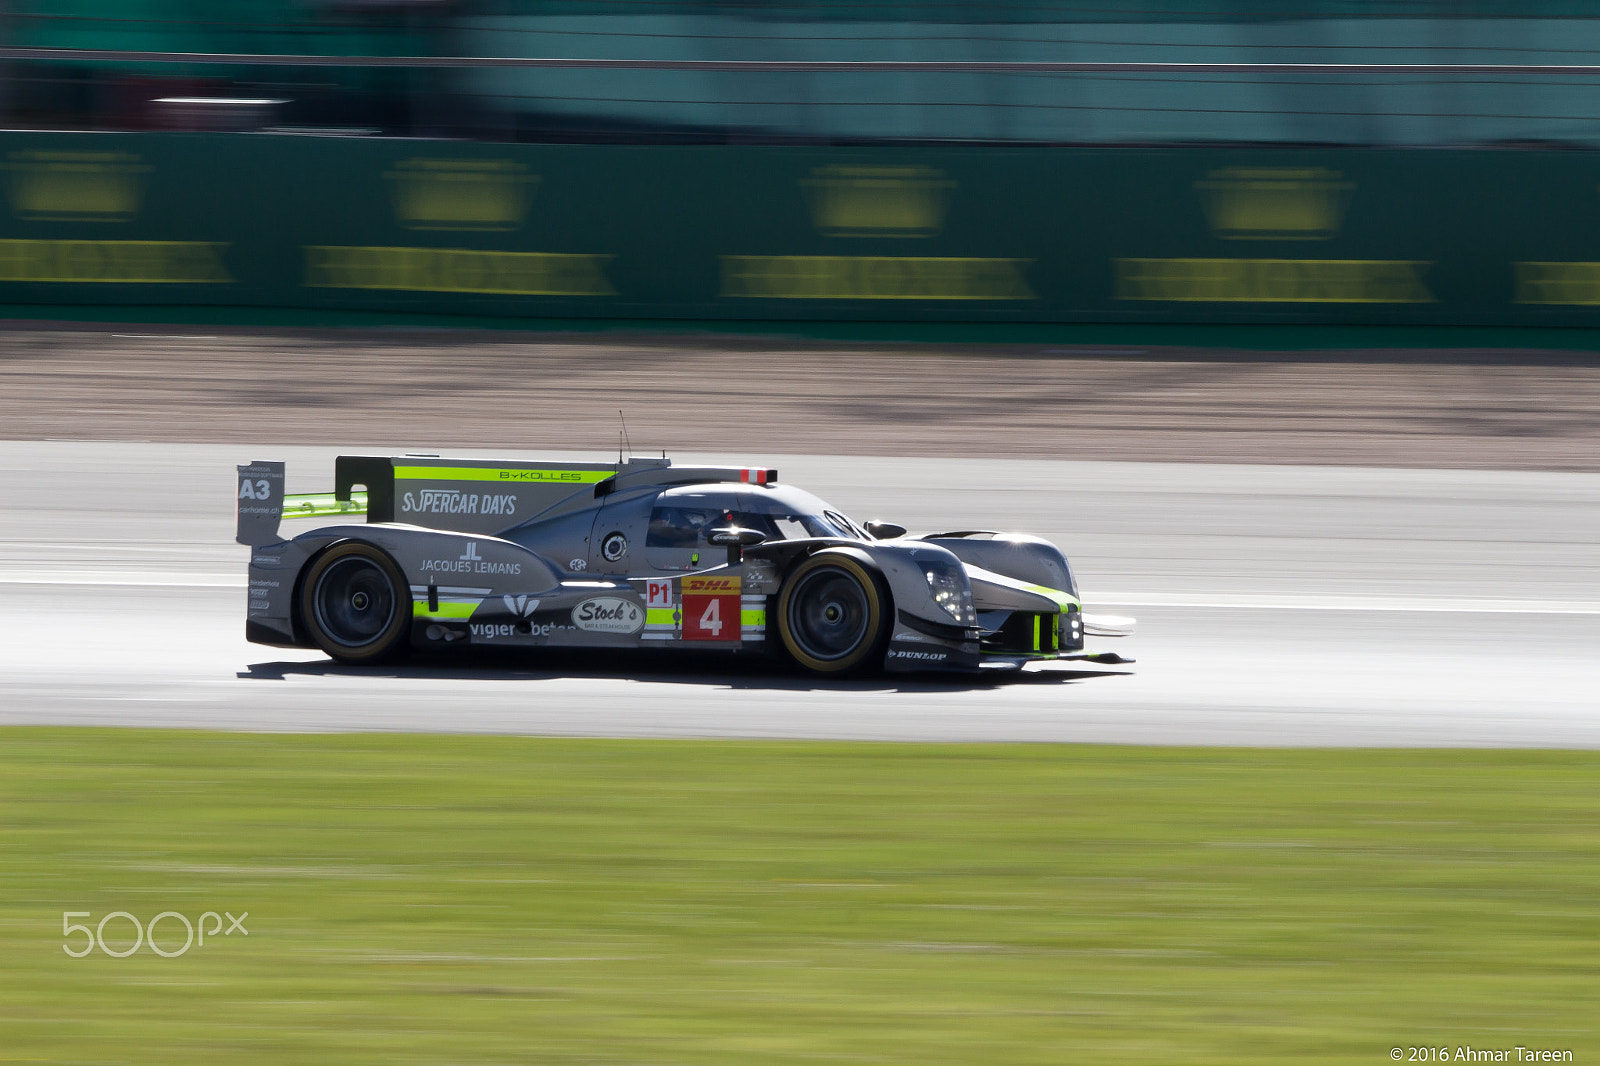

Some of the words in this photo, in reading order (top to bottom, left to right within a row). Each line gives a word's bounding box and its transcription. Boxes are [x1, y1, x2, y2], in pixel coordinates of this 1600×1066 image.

[239, 479, 271, 500] A3
[402, 489, 479, 514] SUPERCAR
[480, 495, 517, 515] DAYS
[420, 560, 472, 574] JACQUES
[474, 562, 522, 575] LEMANS
[650, 583, 668, 603] P1
[690, 580, 731, 591] DHL
[699, 599, 723, 636] 4
[896, 650, 947, 661] DUNLOP
